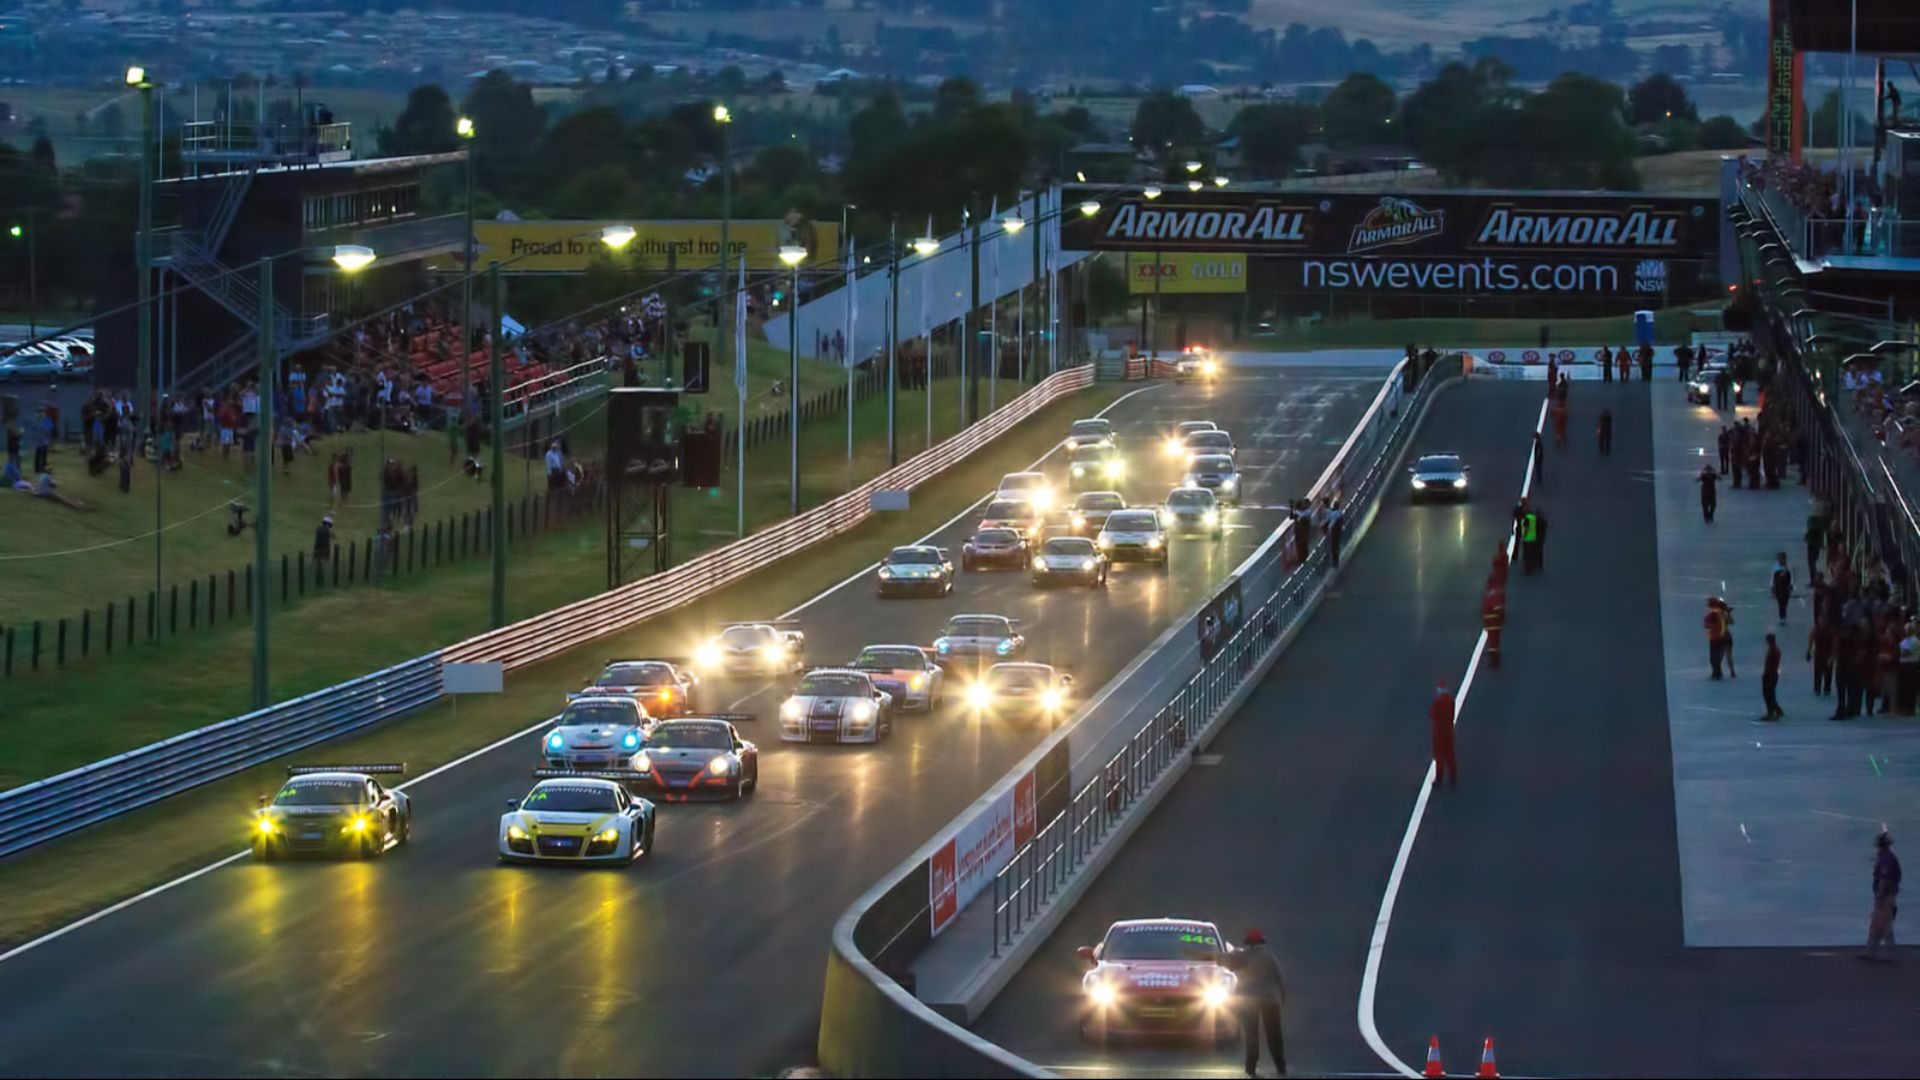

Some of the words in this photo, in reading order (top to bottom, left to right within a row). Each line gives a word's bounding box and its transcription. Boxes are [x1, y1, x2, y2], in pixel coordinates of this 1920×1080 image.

[511, 238, 563, 255] Proud
[567, 238, 584, 255] to
[1138, 263, 1178, 278] XXXX
[1191, 260, 1242, 280] GOLD
[1303, 257, 1617, 290] nswevents.com
